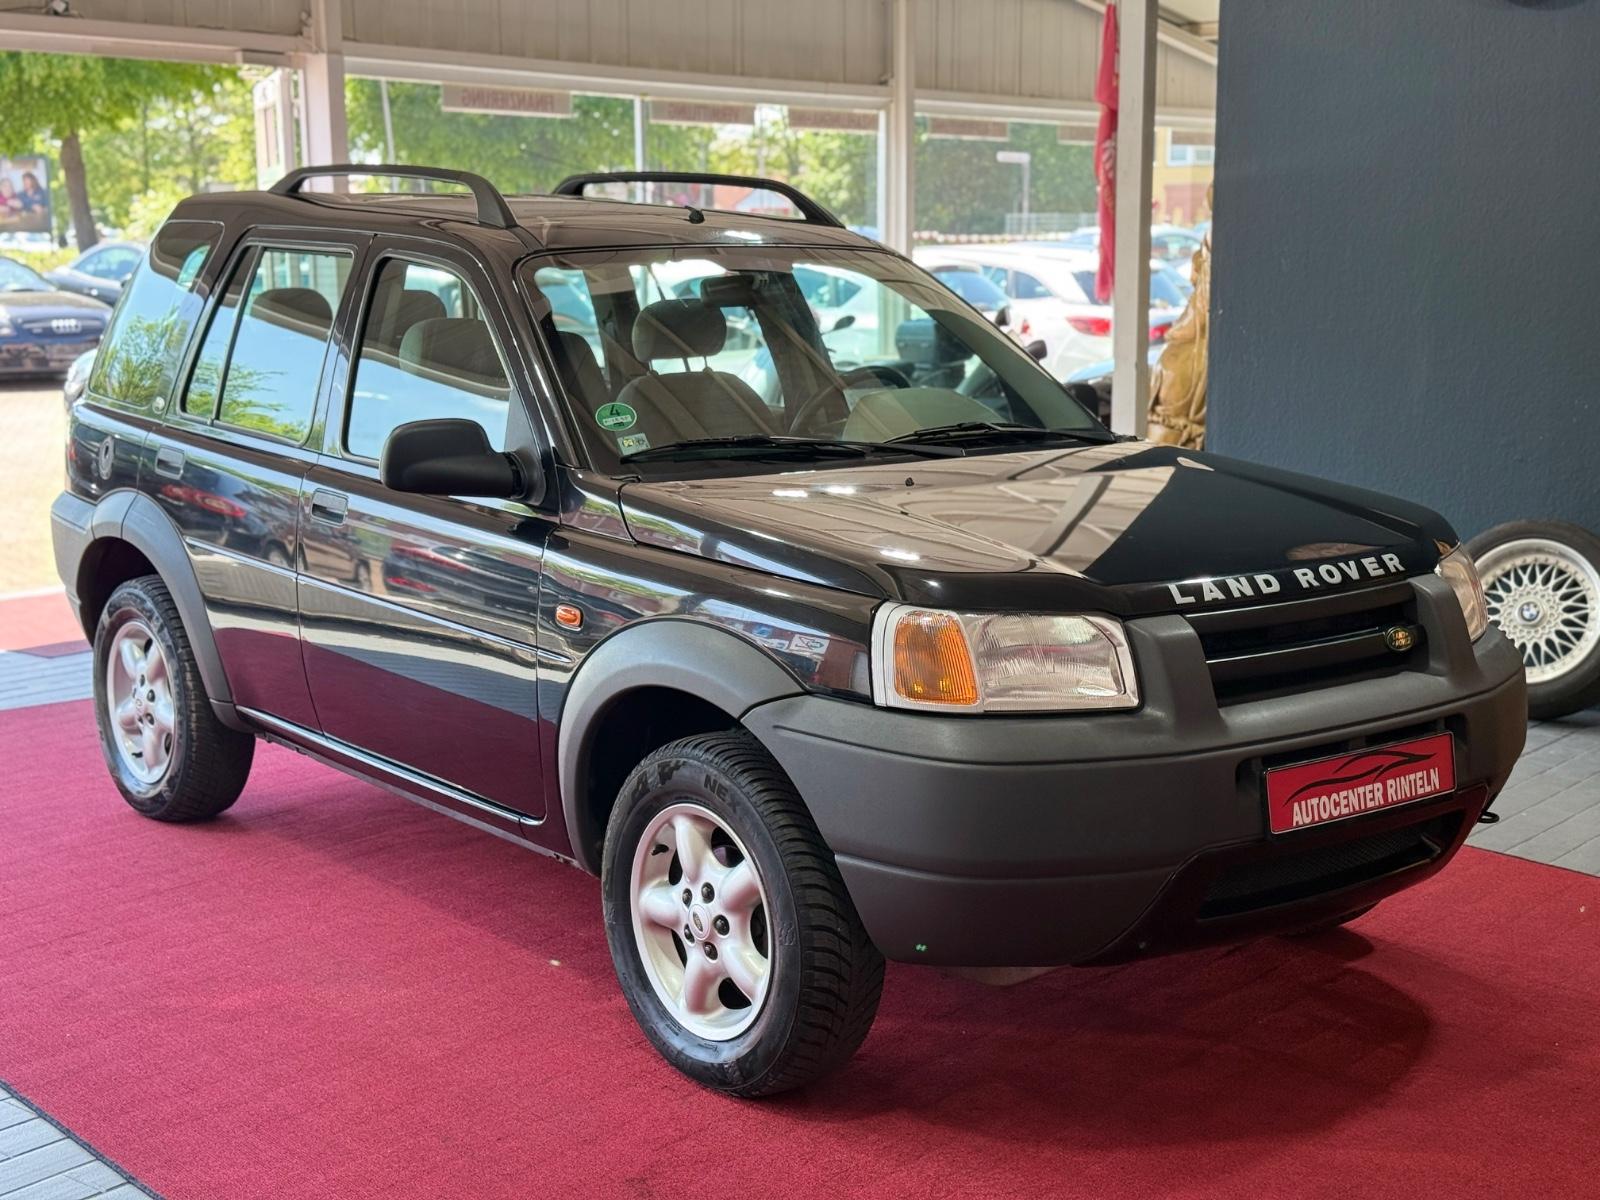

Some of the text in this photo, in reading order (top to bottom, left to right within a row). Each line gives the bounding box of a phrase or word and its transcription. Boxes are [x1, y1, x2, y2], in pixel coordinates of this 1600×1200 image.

[609, 405, 620, 416] 4
[1168, 553, 1405, 605] LAND ROVER
[1292, 768, 1440, 827] AUTOCENTER RINTELN
